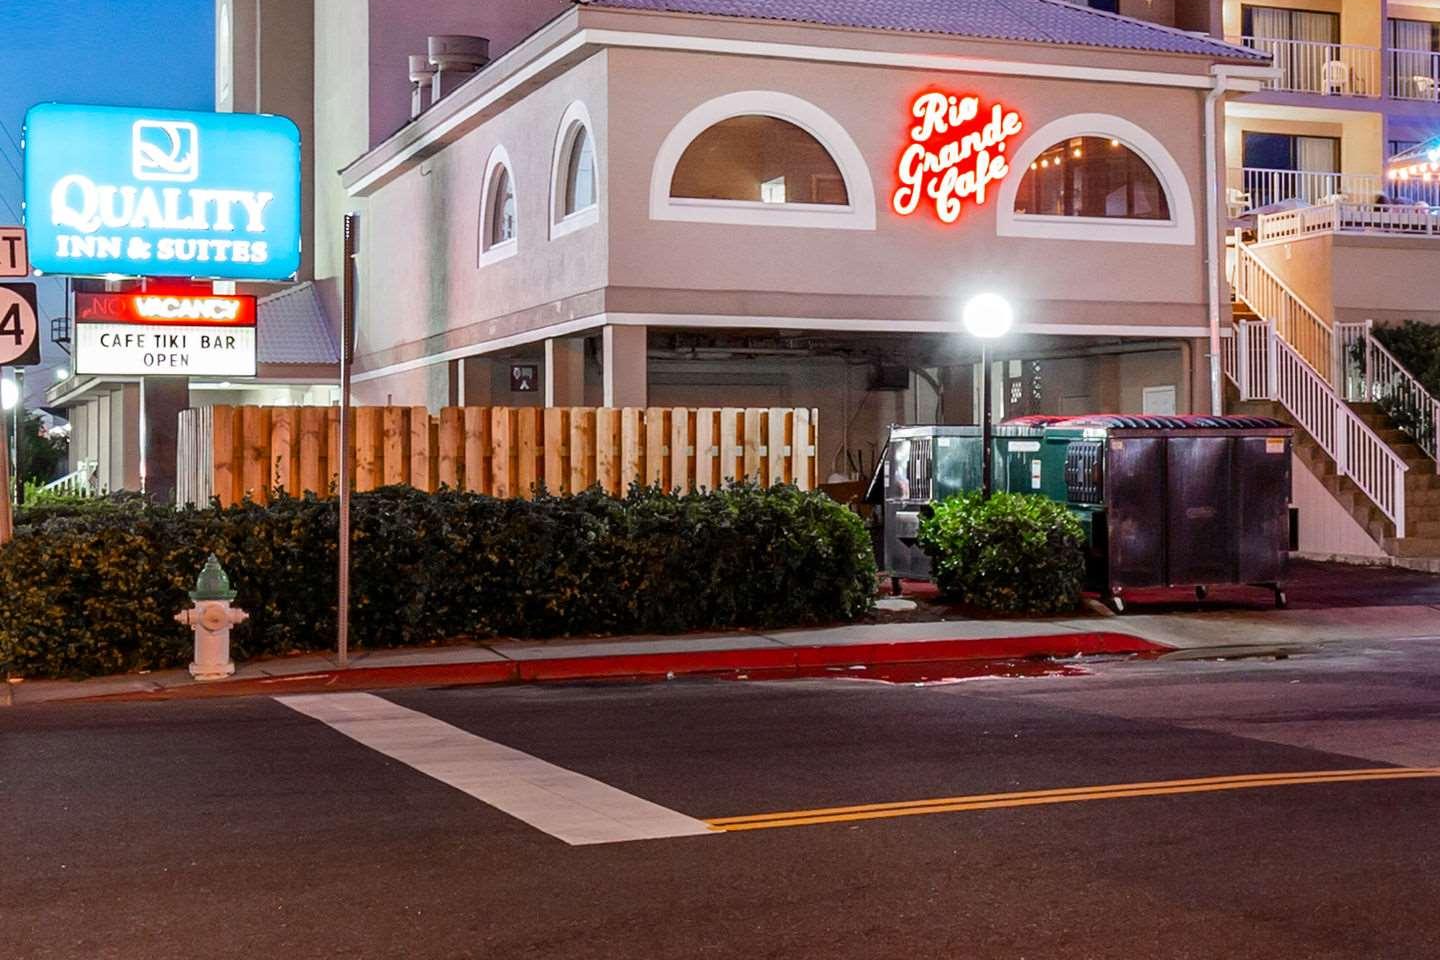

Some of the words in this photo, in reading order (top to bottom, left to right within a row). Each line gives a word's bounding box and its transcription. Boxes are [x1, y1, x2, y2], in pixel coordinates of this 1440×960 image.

[911, 92, 979, 142] Rio
[893, 104, 1022, 216] Grande
[51, 174, 273, 233] QUALITY
[56, 236, 120, 259] INN
[127, 237, 151, 259] &
[156, 238, 268, 263] SUITES
[133, 295, 240, 320] VACANCY
[100, 333, 145, 348] CAFE
[154, 335, 187, 349] TIKI
[200, 335, 236, 350] BAR
[143, 353, 189, 367] OPEN
